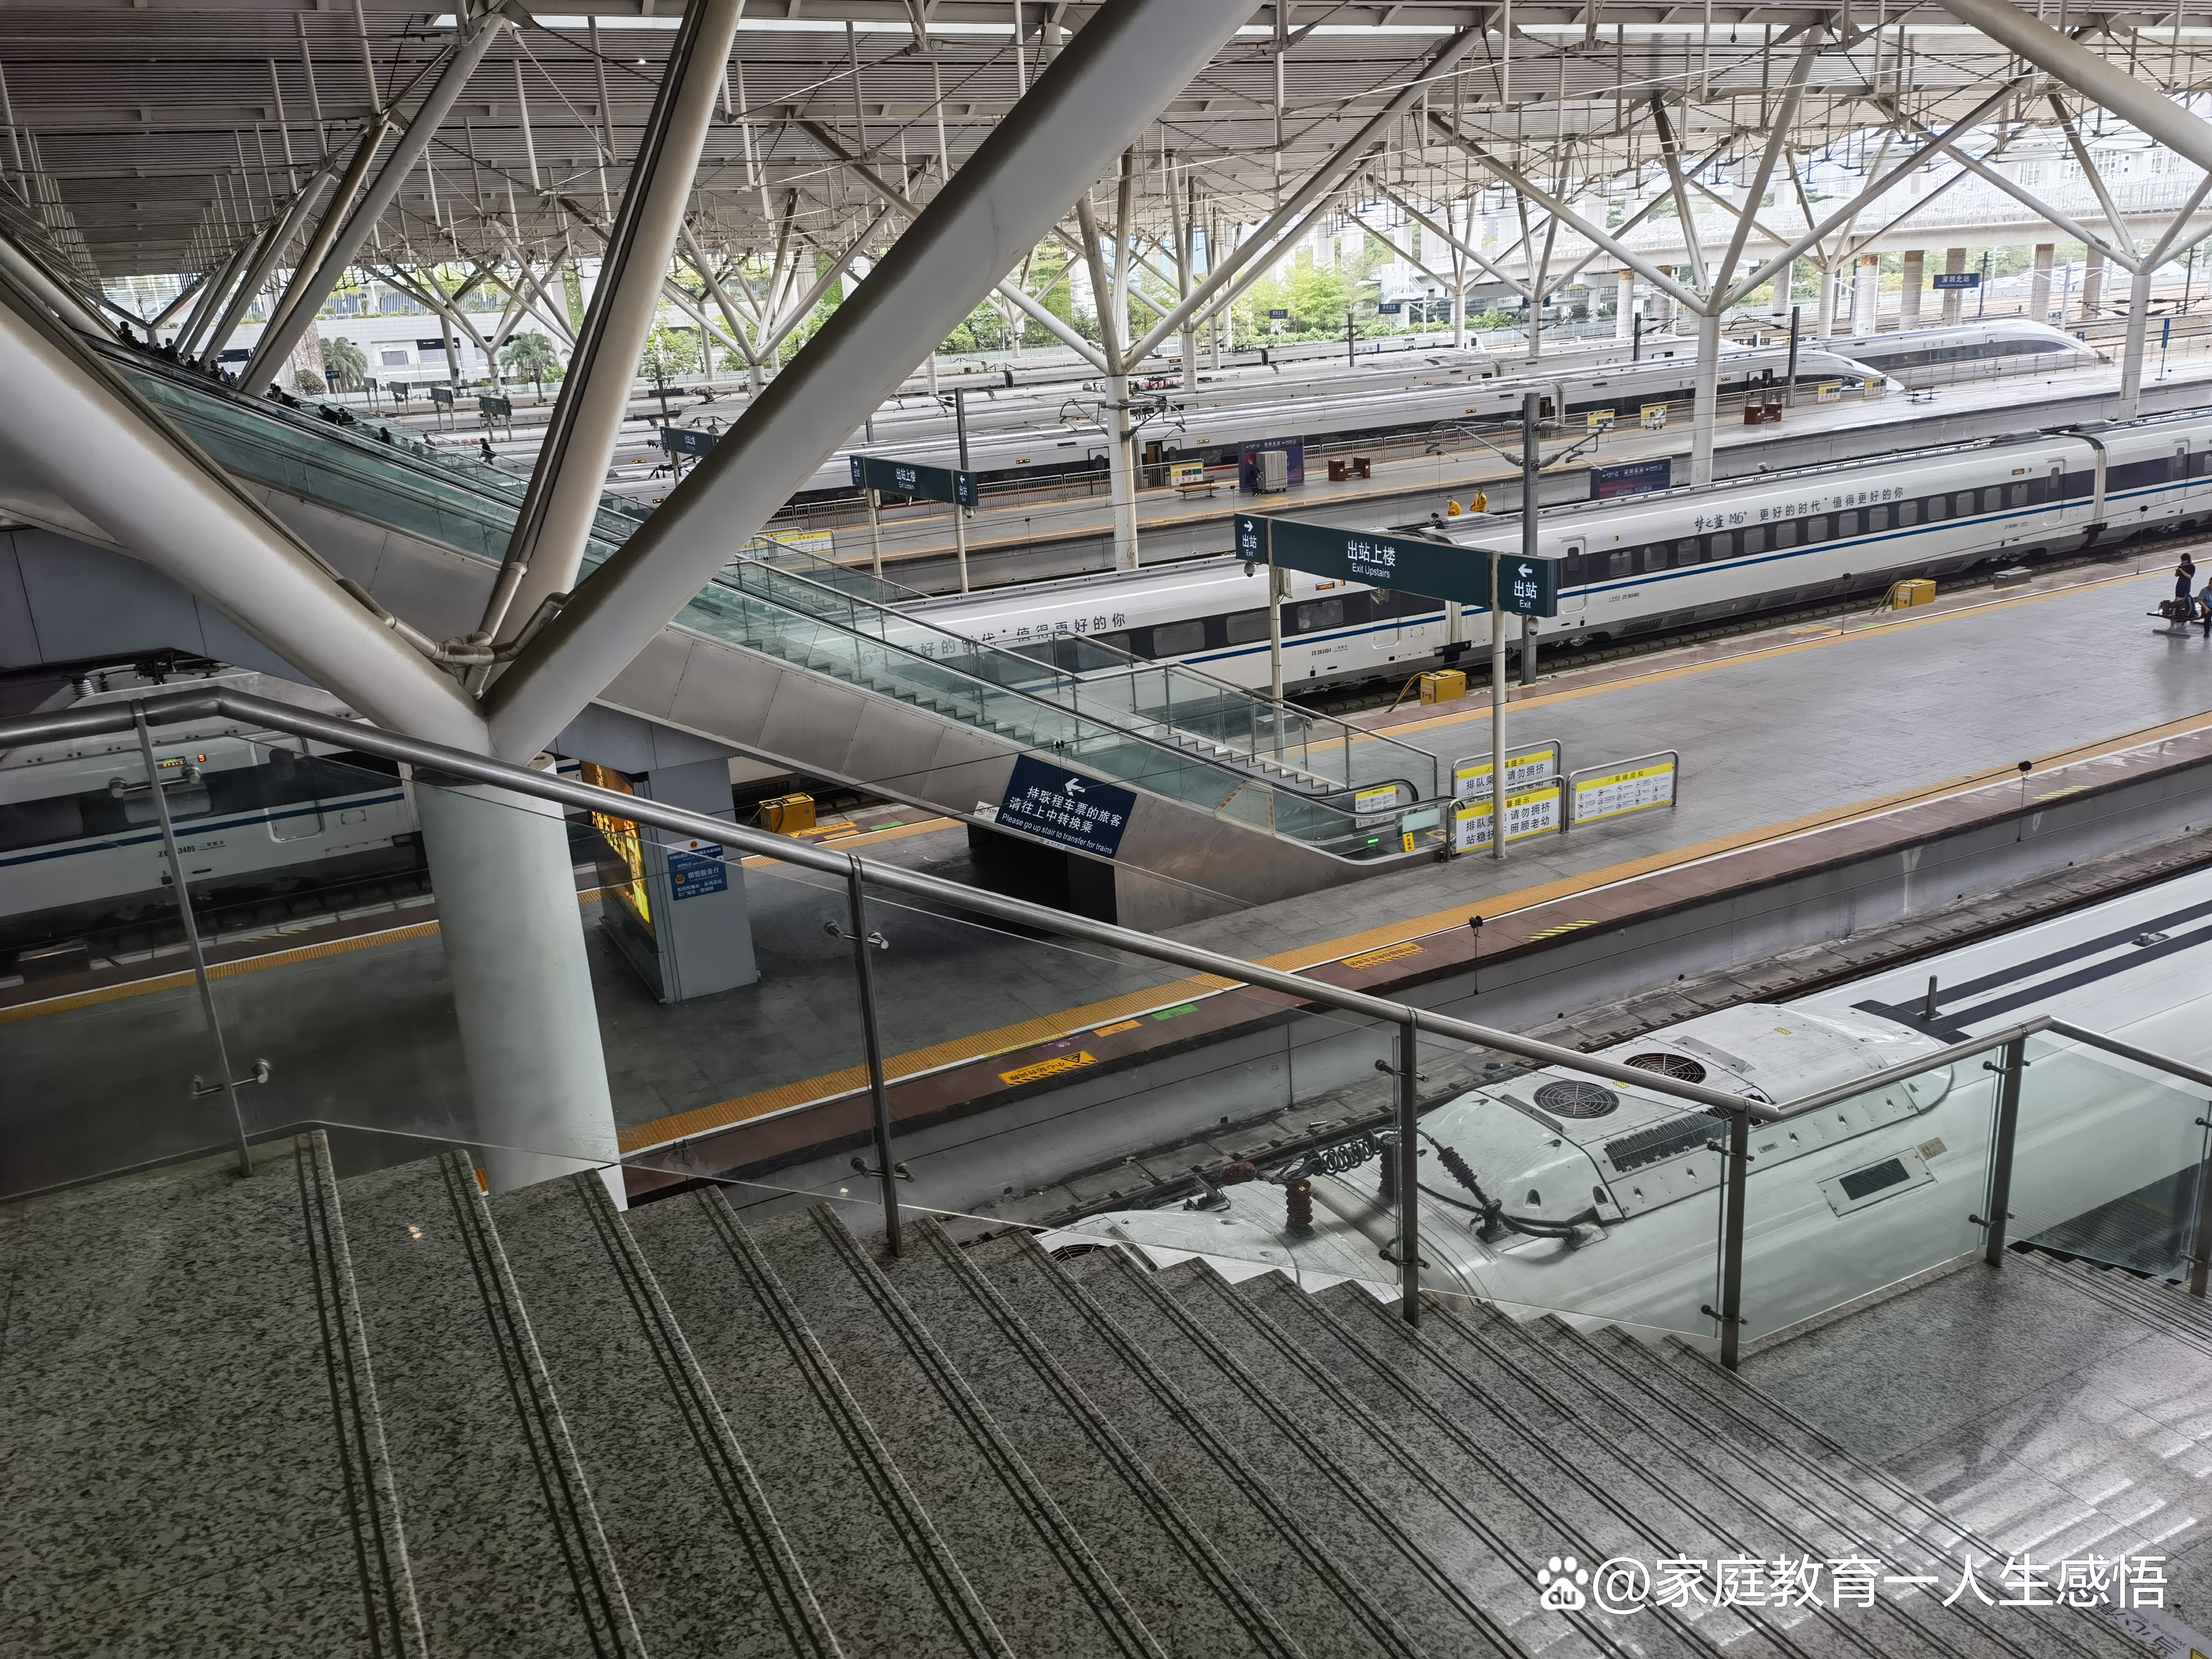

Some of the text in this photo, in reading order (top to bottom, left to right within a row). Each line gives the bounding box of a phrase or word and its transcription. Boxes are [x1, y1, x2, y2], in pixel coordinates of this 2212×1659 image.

[1678, 379, 1695, 388] 复兴
[896, 467, 916, 483] 出站上楼
[959, 485, 968, 496] 出站
[1695, 514, 1724, 535] 梦之蓝
[1243, 534, 1257, 549] 出站
[1347, 540, 1396, 567] 出站上楼
[1352, 563, 1391, 579] Exit Upstairs
[1514, 579, 1537, 599] 出站
[1519, 599, 1531, 609] Exit
[1466, 763, 1545, 790] 排队乘 请勿拥挤
[1009, 796, 1094, 833] 请往上中转换乘
[1027, 786, 1123, 827] 持联程车票的旅客
[1510, 801, 1550, 820] 请勿拥挤
[1002, 813, 1023, 826] Please
[1025, 821, 1032, 830] go
[1033, 824, 1041, 833] up
[1042, 826, 1055, 837] stair
[1056, 830, 1062, 838] to
[1063, 832, 1087, 846] transfer
[1087, 839, 1096, 848] for
[1096, 843, 1113, 854] trains
[1510, 815, 1549, 834] 照顾老幼
